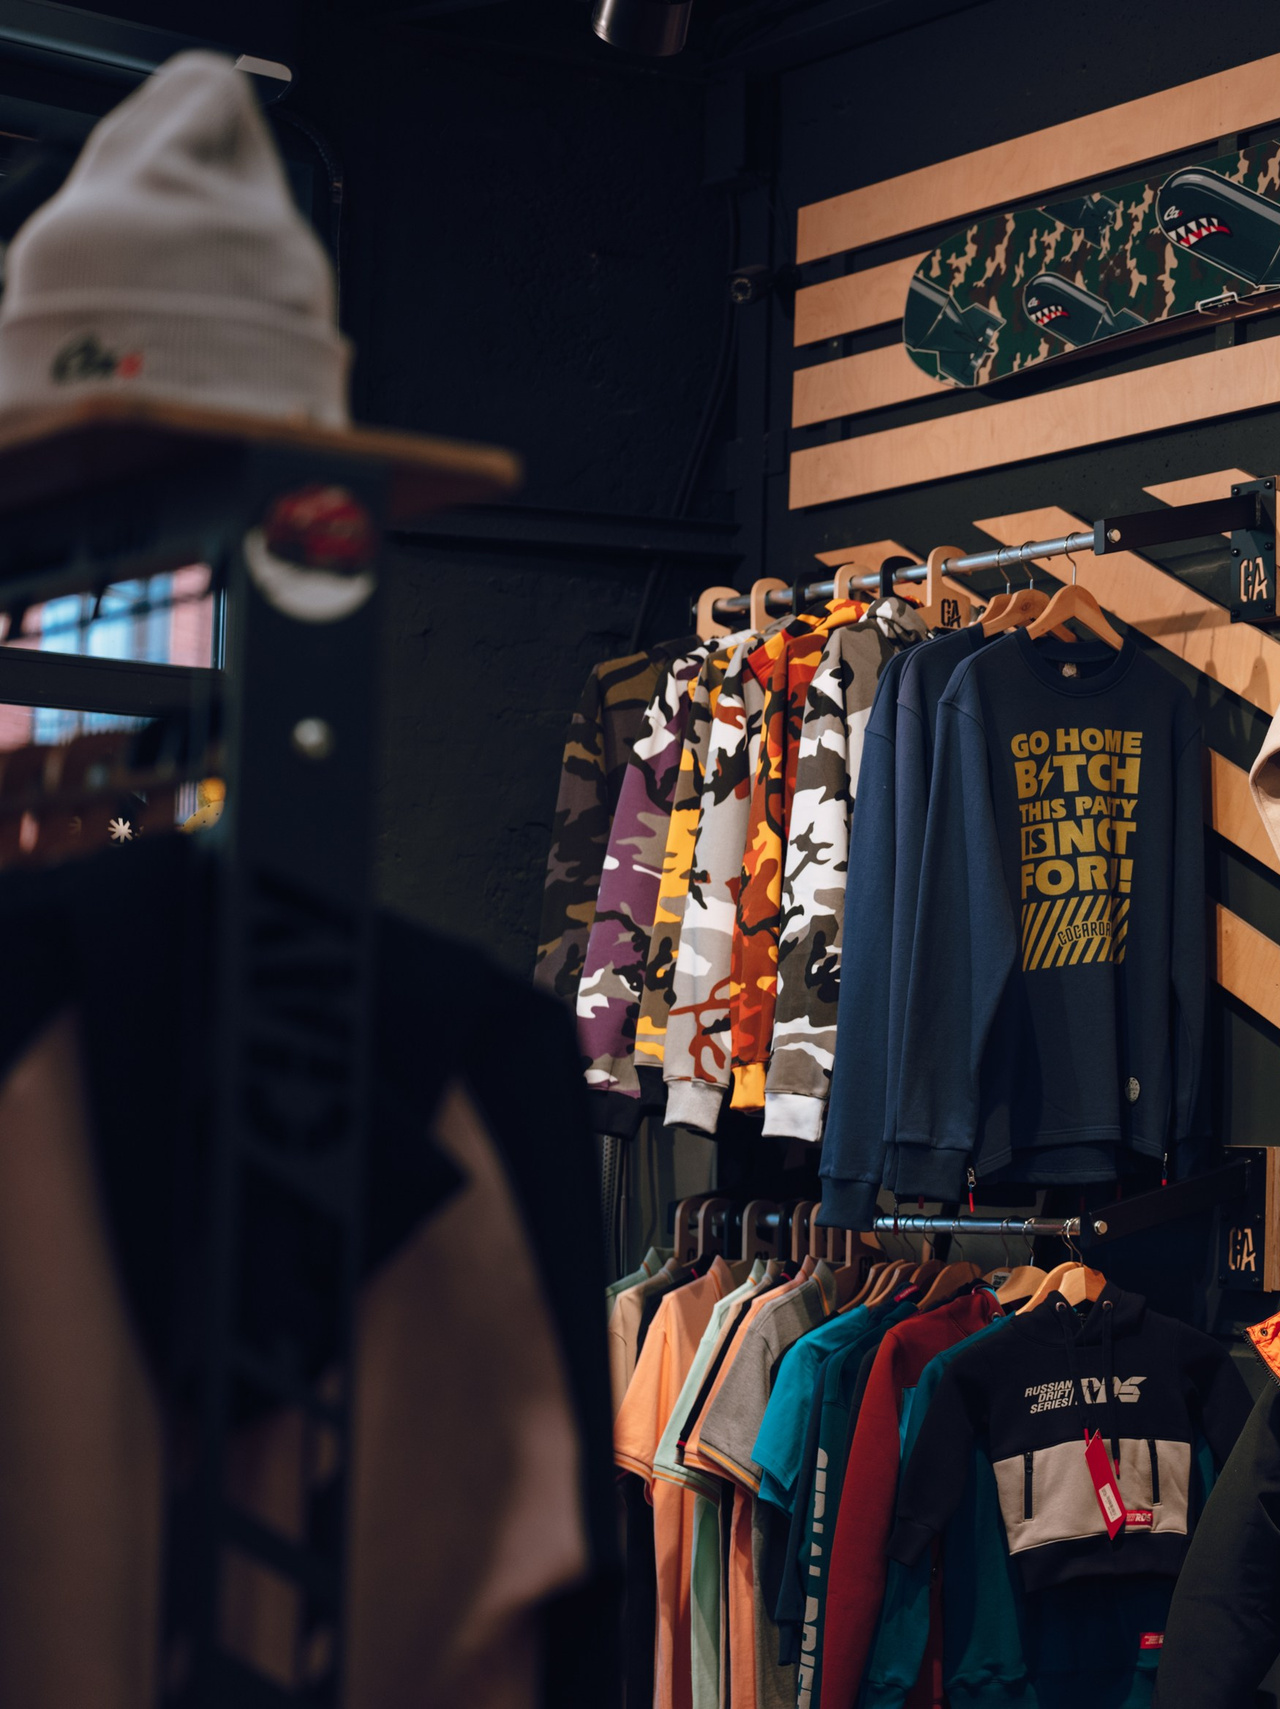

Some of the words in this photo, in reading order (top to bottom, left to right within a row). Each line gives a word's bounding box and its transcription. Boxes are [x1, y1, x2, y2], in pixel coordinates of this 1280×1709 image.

[1240, 556, 1268, 602] CA
[941, 598, 961, 628] CA
[1010, 730, 1050, 759] GO
[1056, 727, 1143, 755] HOME
[1019, 798, 1067, 824] THIS
[1023, 825, 1051, 859] IS
[1229, 1227, 1256, 1271] CA
[1024, 1380, 1073, 1398] RUSSIAN
[1037, 1388, 1072, 1403] DRIFT
[1029, 1398, 1070, 1415] SERIES
